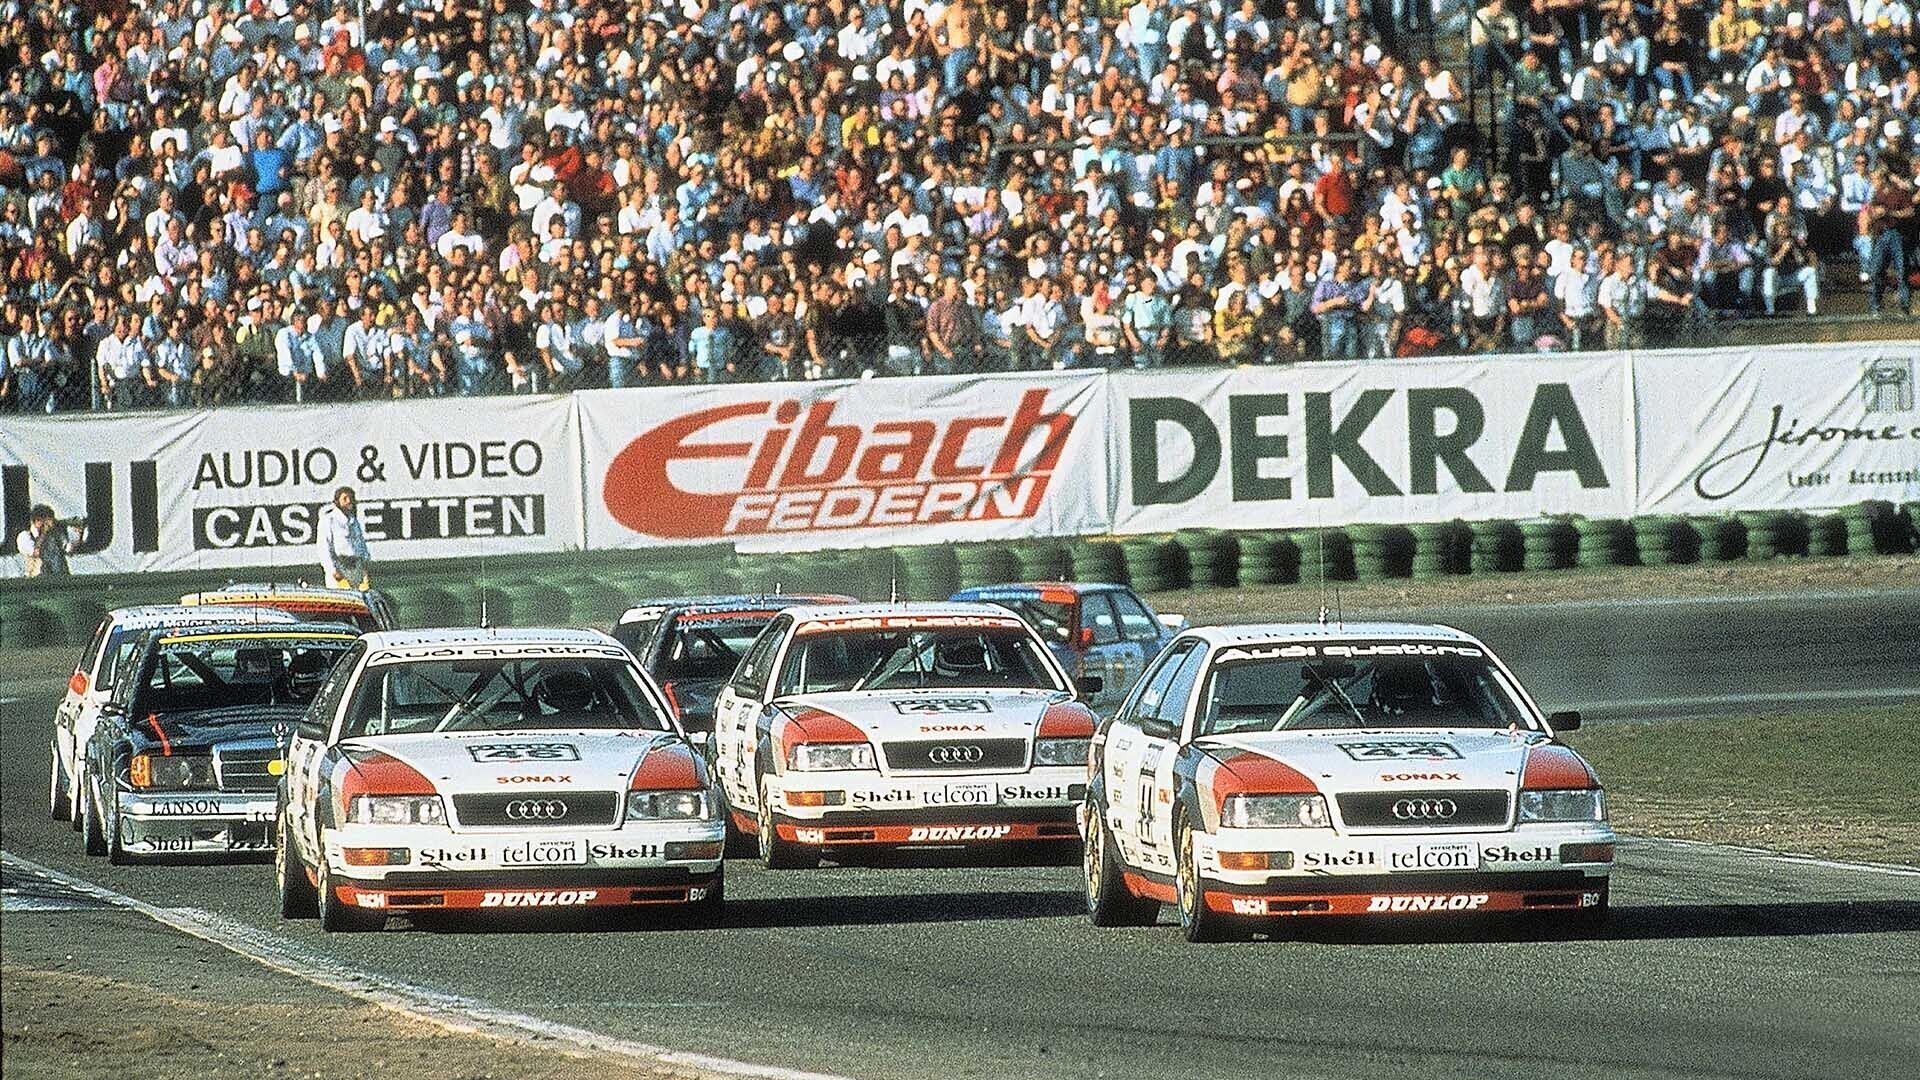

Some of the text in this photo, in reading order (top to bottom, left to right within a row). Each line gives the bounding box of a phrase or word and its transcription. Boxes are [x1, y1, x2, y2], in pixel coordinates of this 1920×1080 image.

[1128, 382, 1611, 507] DEKRA
[192, 439, 543, 490] AUDIO & VIDEO
[722, 474, 1035, 534] FEDERN
[204, 497, 535, 549] CASETTEN
[377, 646, 625, 660] Audi quattro
[1214, 643, 1483, 663] Audi quattro
[496, 775, 571, 784] SONAX
[1380, 772, 1461, 782] SONAX
[852, 784, 1061, 804] Shell telcon Shell
[151, 800, 220, 816] LANSON
[908, 826, 1011, 841] DUNLOP
[143, 835, 193, 852] Shell
[419, 841, 657, 863] Shell telcon Shell
[1303, 845, 1552, 868] Shell telcon Shell
[479, 890, 597, 907] DUNLOP
[1366, 894, 1488, 911] DUNLOP
